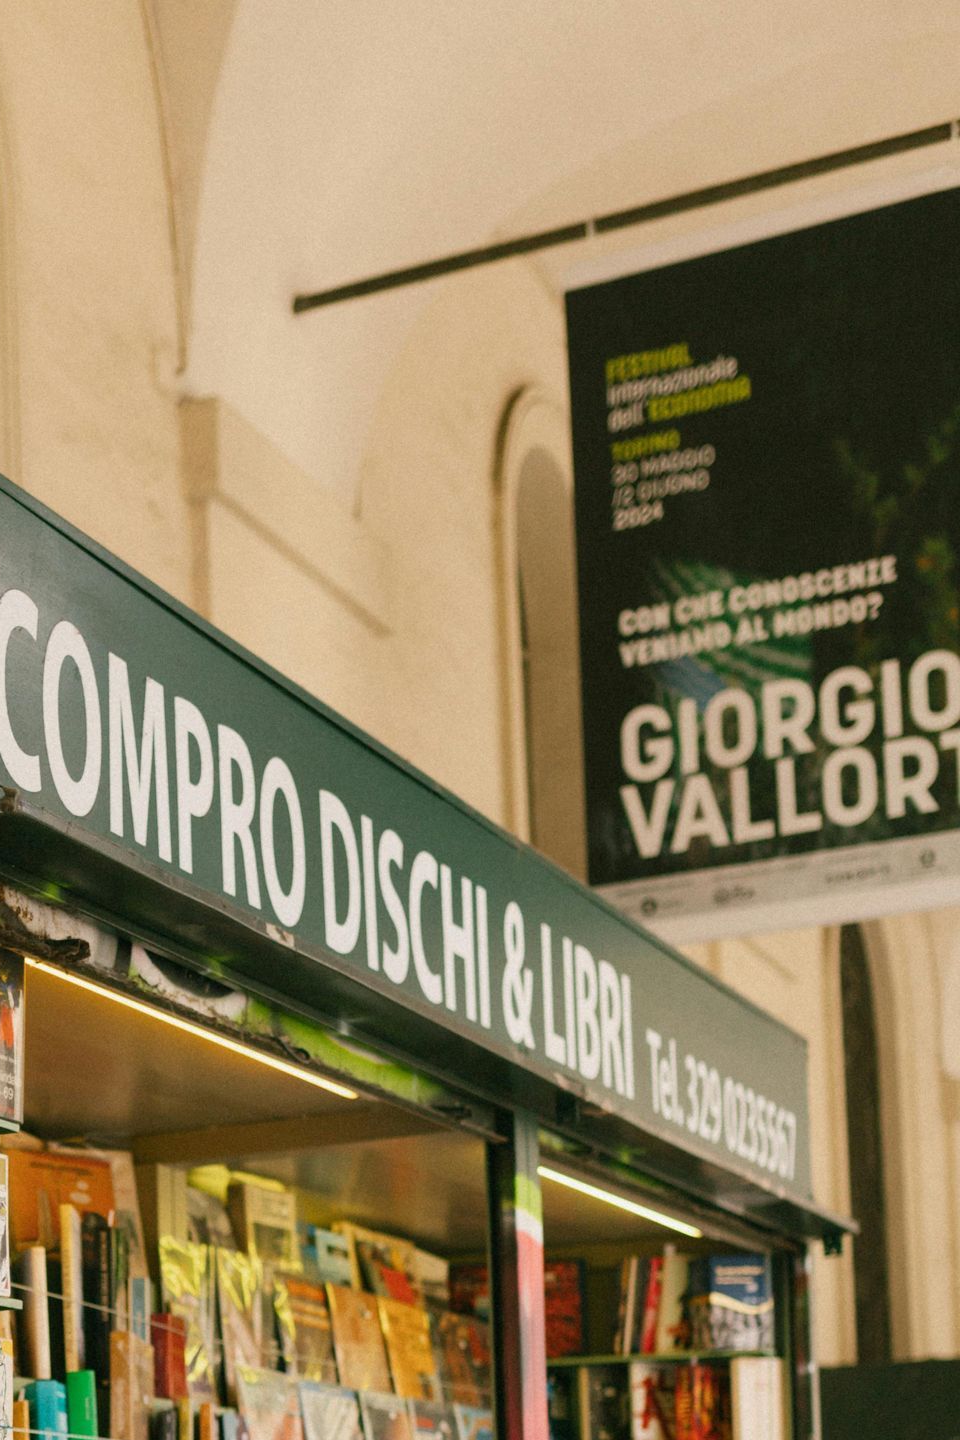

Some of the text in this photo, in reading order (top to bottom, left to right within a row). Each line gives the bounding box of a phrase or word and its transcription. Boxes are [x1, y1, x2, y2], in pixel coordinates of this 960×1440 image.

[611, 428, 681, 462] TORINO
[611, 444, 716, 487] 30 MAGGIO
[636, 468, 711, 502] GIUGNO
[613, 499, 665, 531] 2024
[618, 554, 898, 636] CON CHE CONOSCENZE
[735, 615, 769, 647] AL
[772, 591, 886, 639] MONDO?
[620, 648, 960, 783] GIORGIO
[319, 789, 491, 1030] DISCHI
[502, 901, 536, 1050] &
[541, 923, 635, 1100] LIBRI
[646, 1028, 685, 1127] Tel.
[684, 1054, 722, 1144] 329
